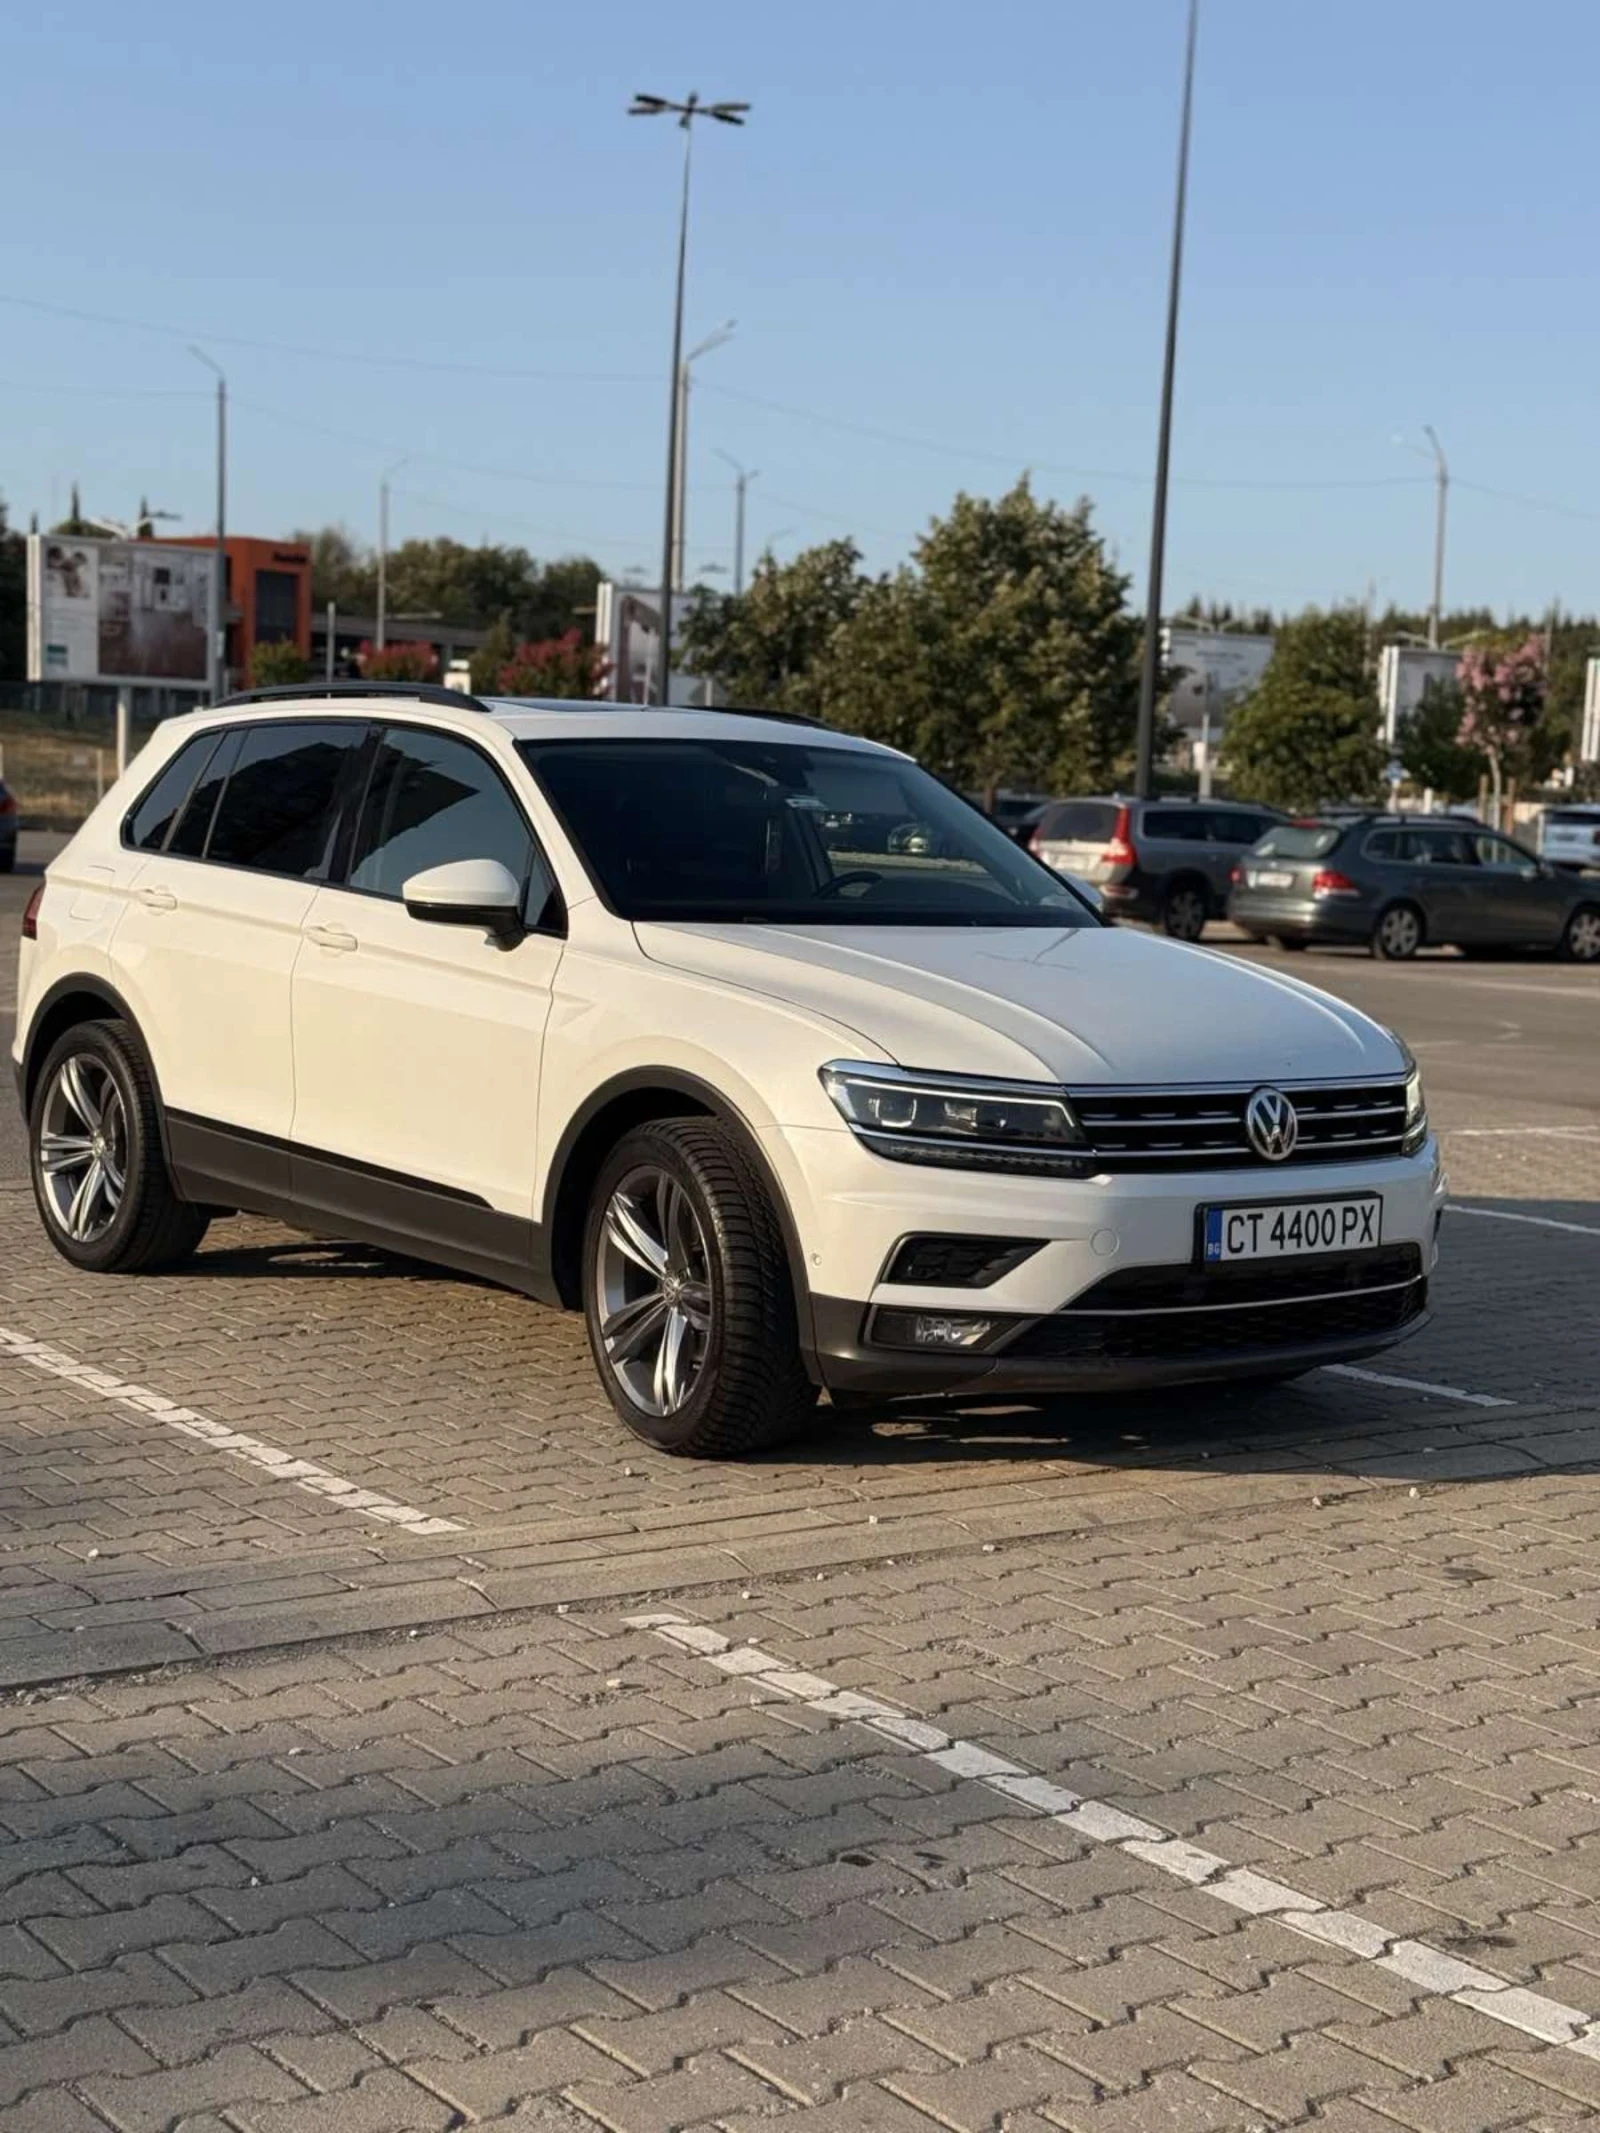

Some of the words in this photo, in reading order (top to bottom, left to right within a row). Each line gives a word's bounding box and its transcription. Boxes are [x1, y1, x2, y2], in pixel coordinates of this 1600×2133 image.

[1248, 1090, 1297, 1159] VW
[1207, 1243, 1220, 1255] BG
[1227, 1214, 1264, 1254] CT
[1270, 1208, 1336, 1250] 4400
[1342, 1205, 1375, 1245] PX
